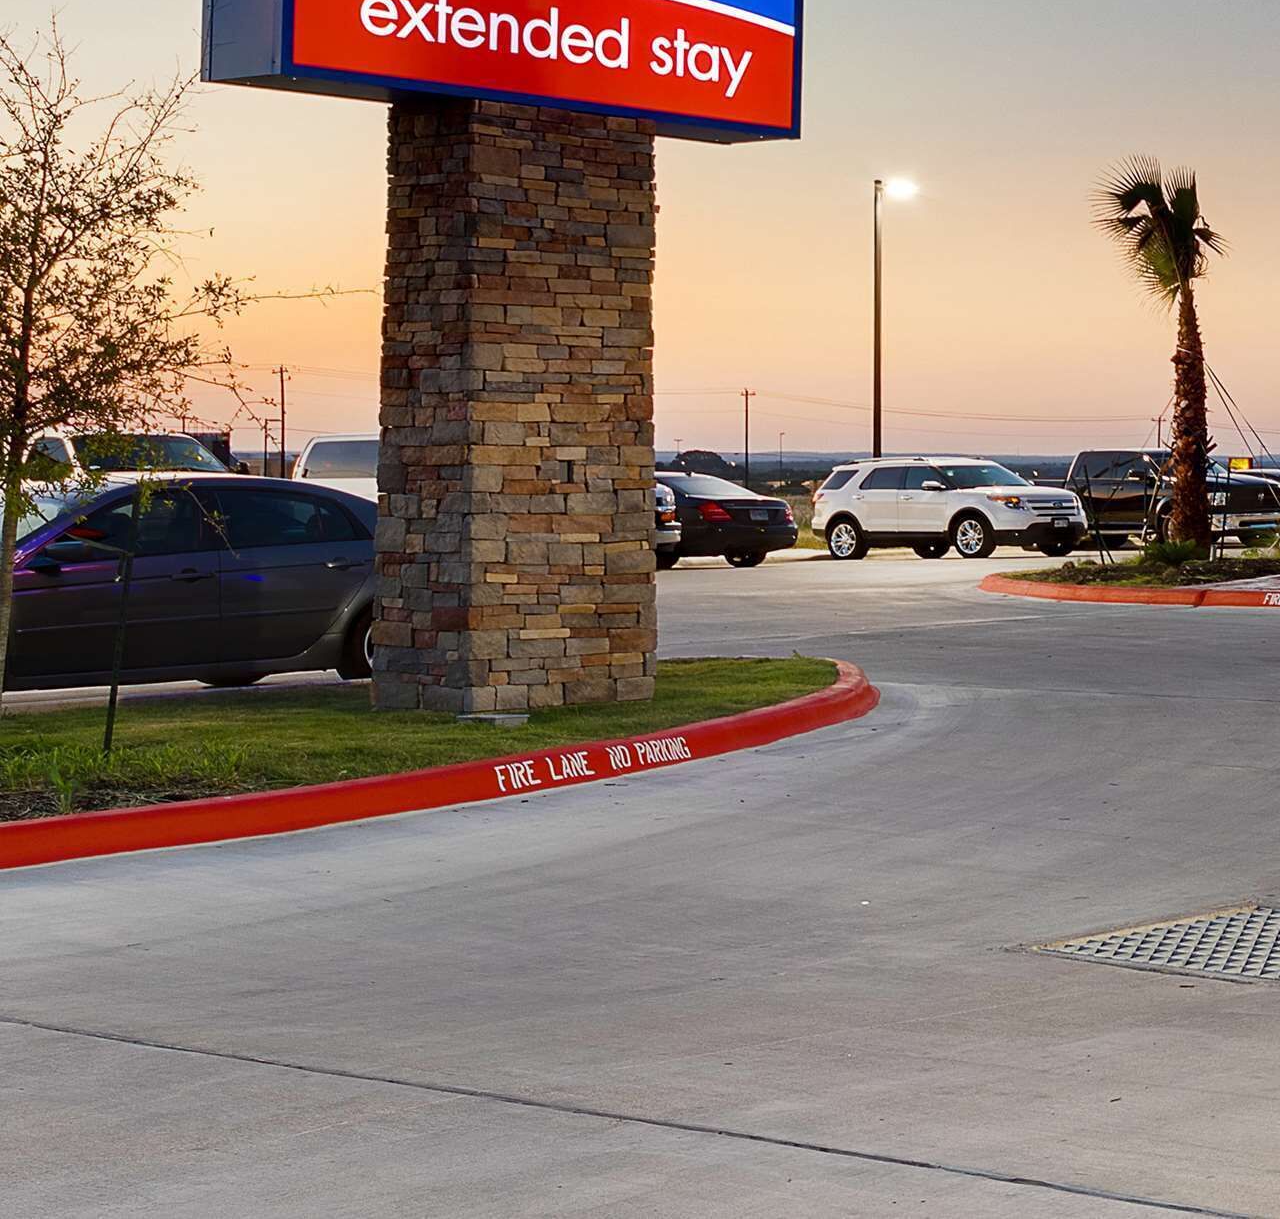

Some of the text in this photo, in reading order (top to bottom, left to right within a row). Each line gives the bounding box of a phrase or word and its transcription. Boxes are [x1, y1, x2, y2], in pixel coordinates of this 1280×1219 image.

[650, 28, 753, 97] stay
[494, 736, 692, 792] FIRE LANE NO PARKING
